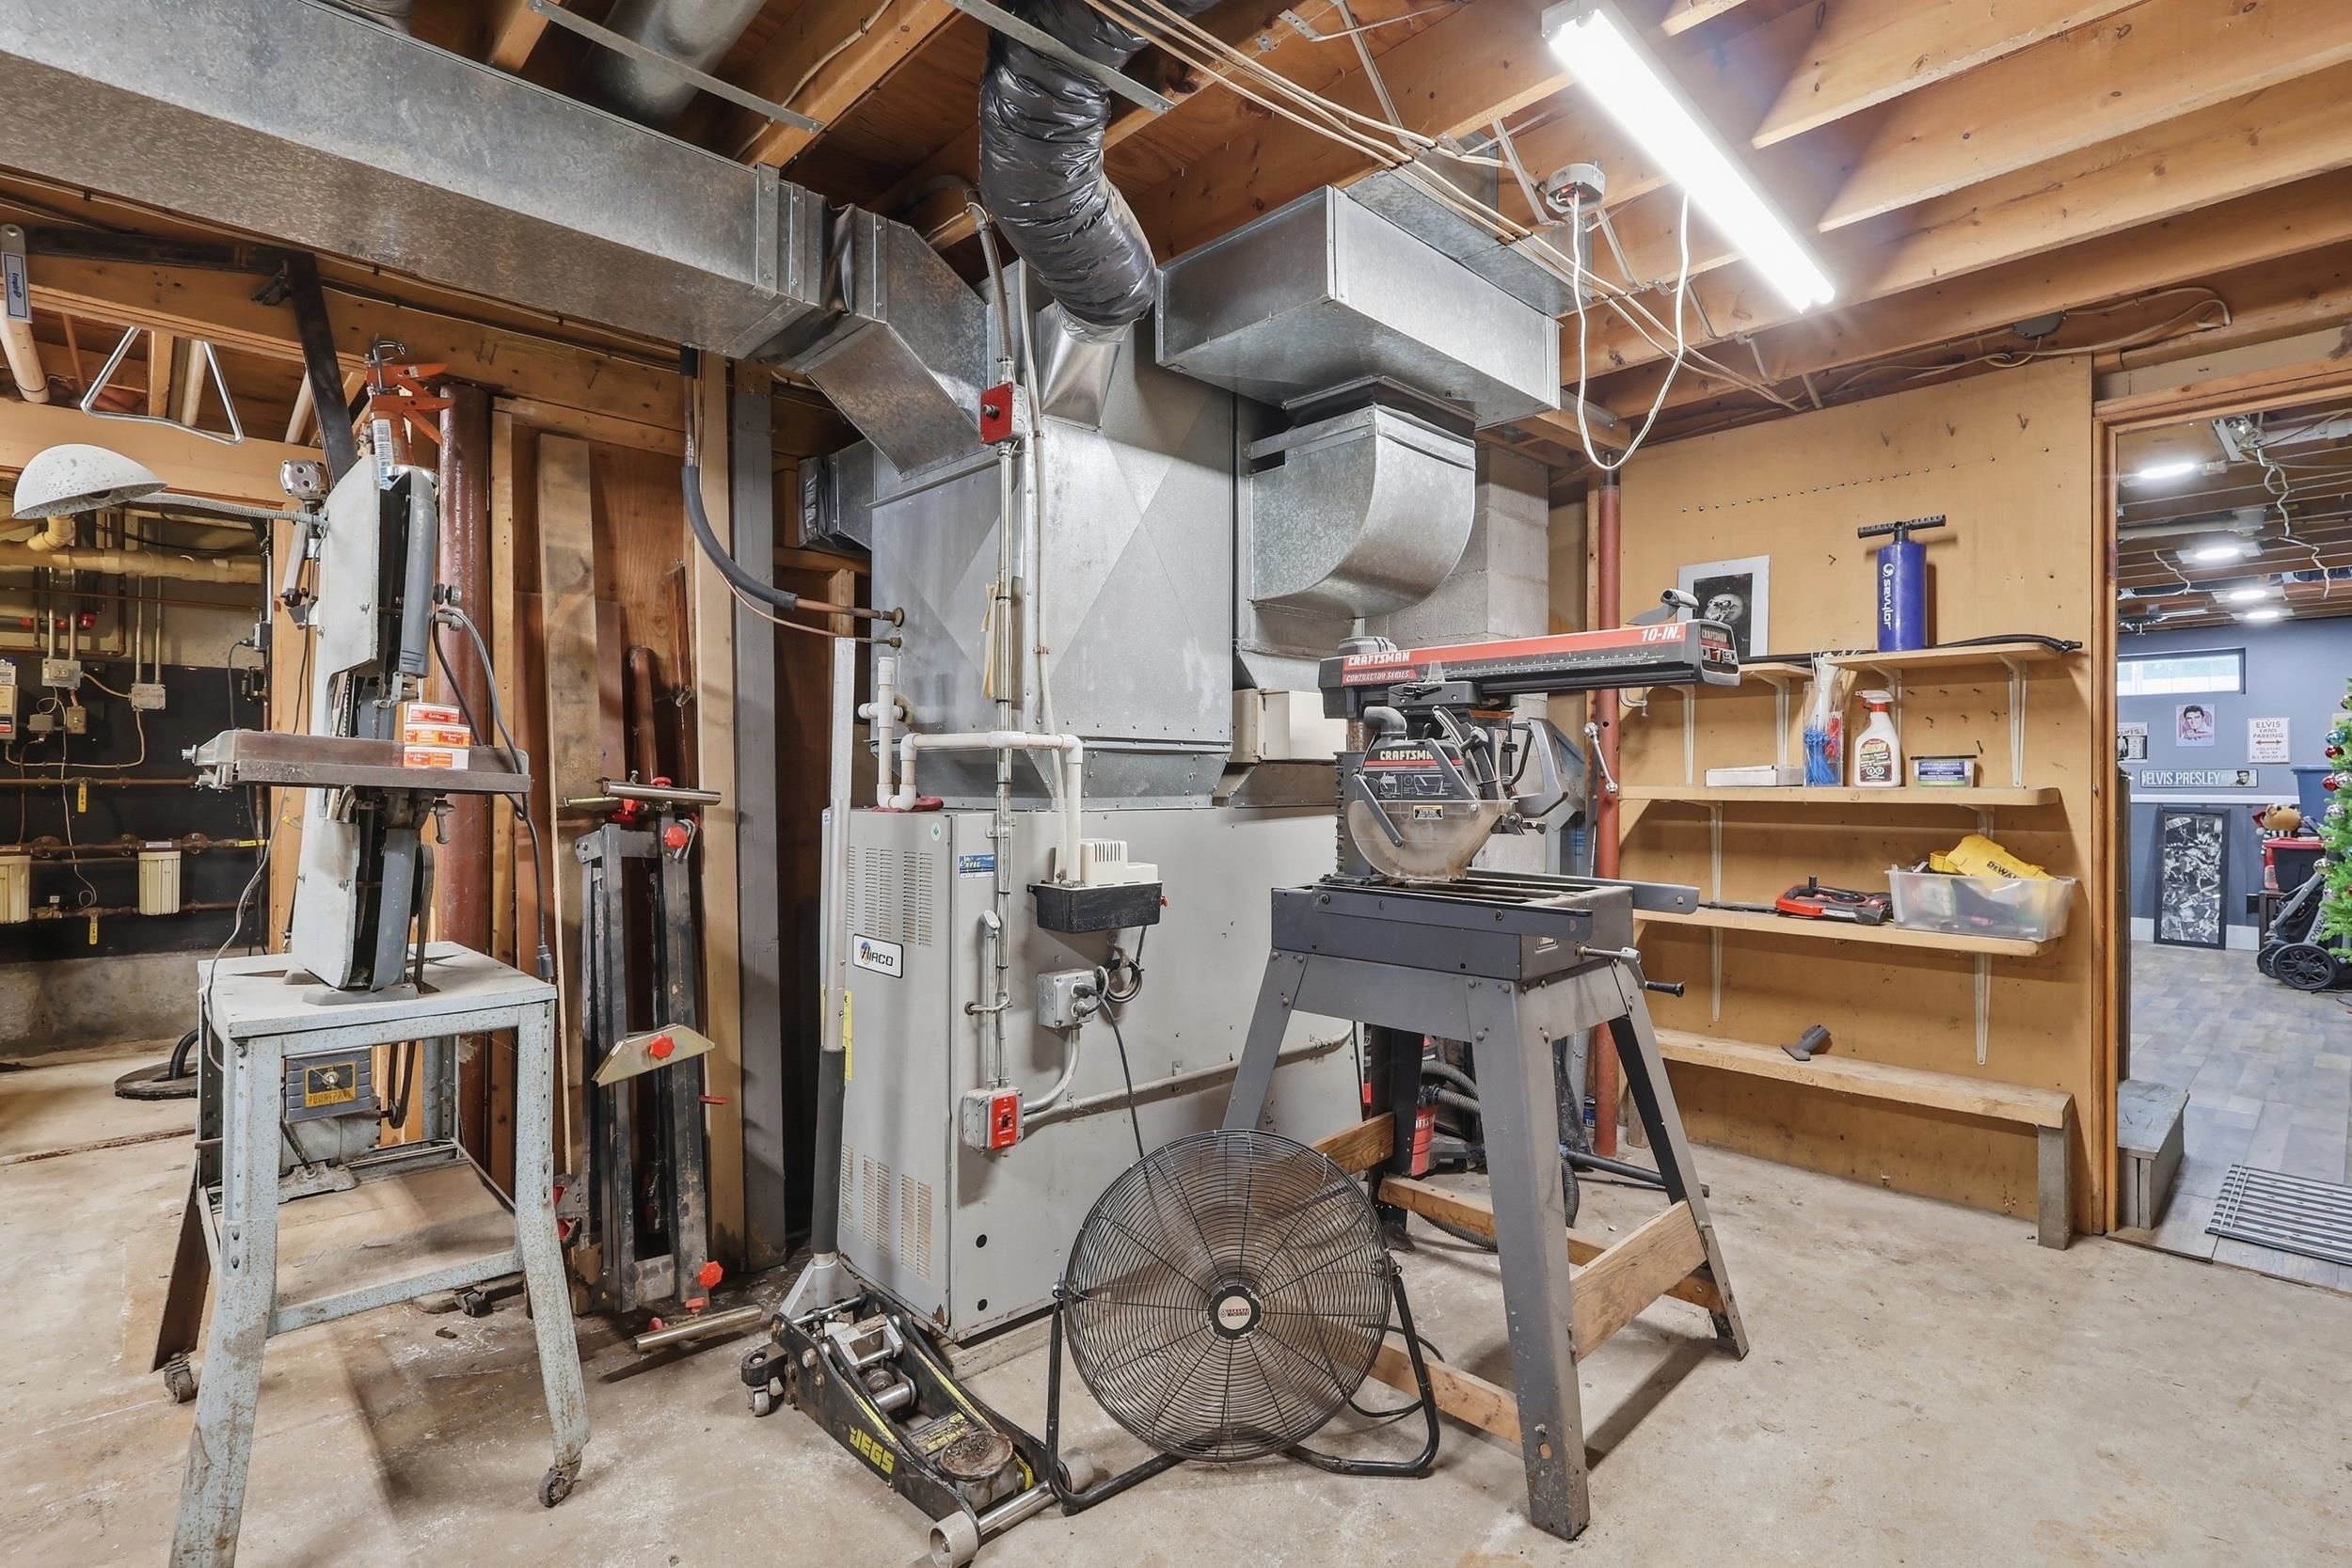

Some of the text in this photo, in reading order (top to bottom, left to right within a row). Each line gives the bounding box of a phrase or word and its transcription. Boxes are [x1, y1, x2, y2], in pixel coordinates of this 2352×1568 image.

[1882, 578, 1894, 631] sevylor
[1642, 626, 1681, 642] 10-IN.
[1348, 651, 1410, 667] CRAFTSMAN
[1379, 751, 1434, 760] CRAFTSMA
[2145, 771, 2173, 785] ELVIS
[2175, 771, 2221, 785] PRESLEY
[850, 1424, 895, 1475] JEGS
